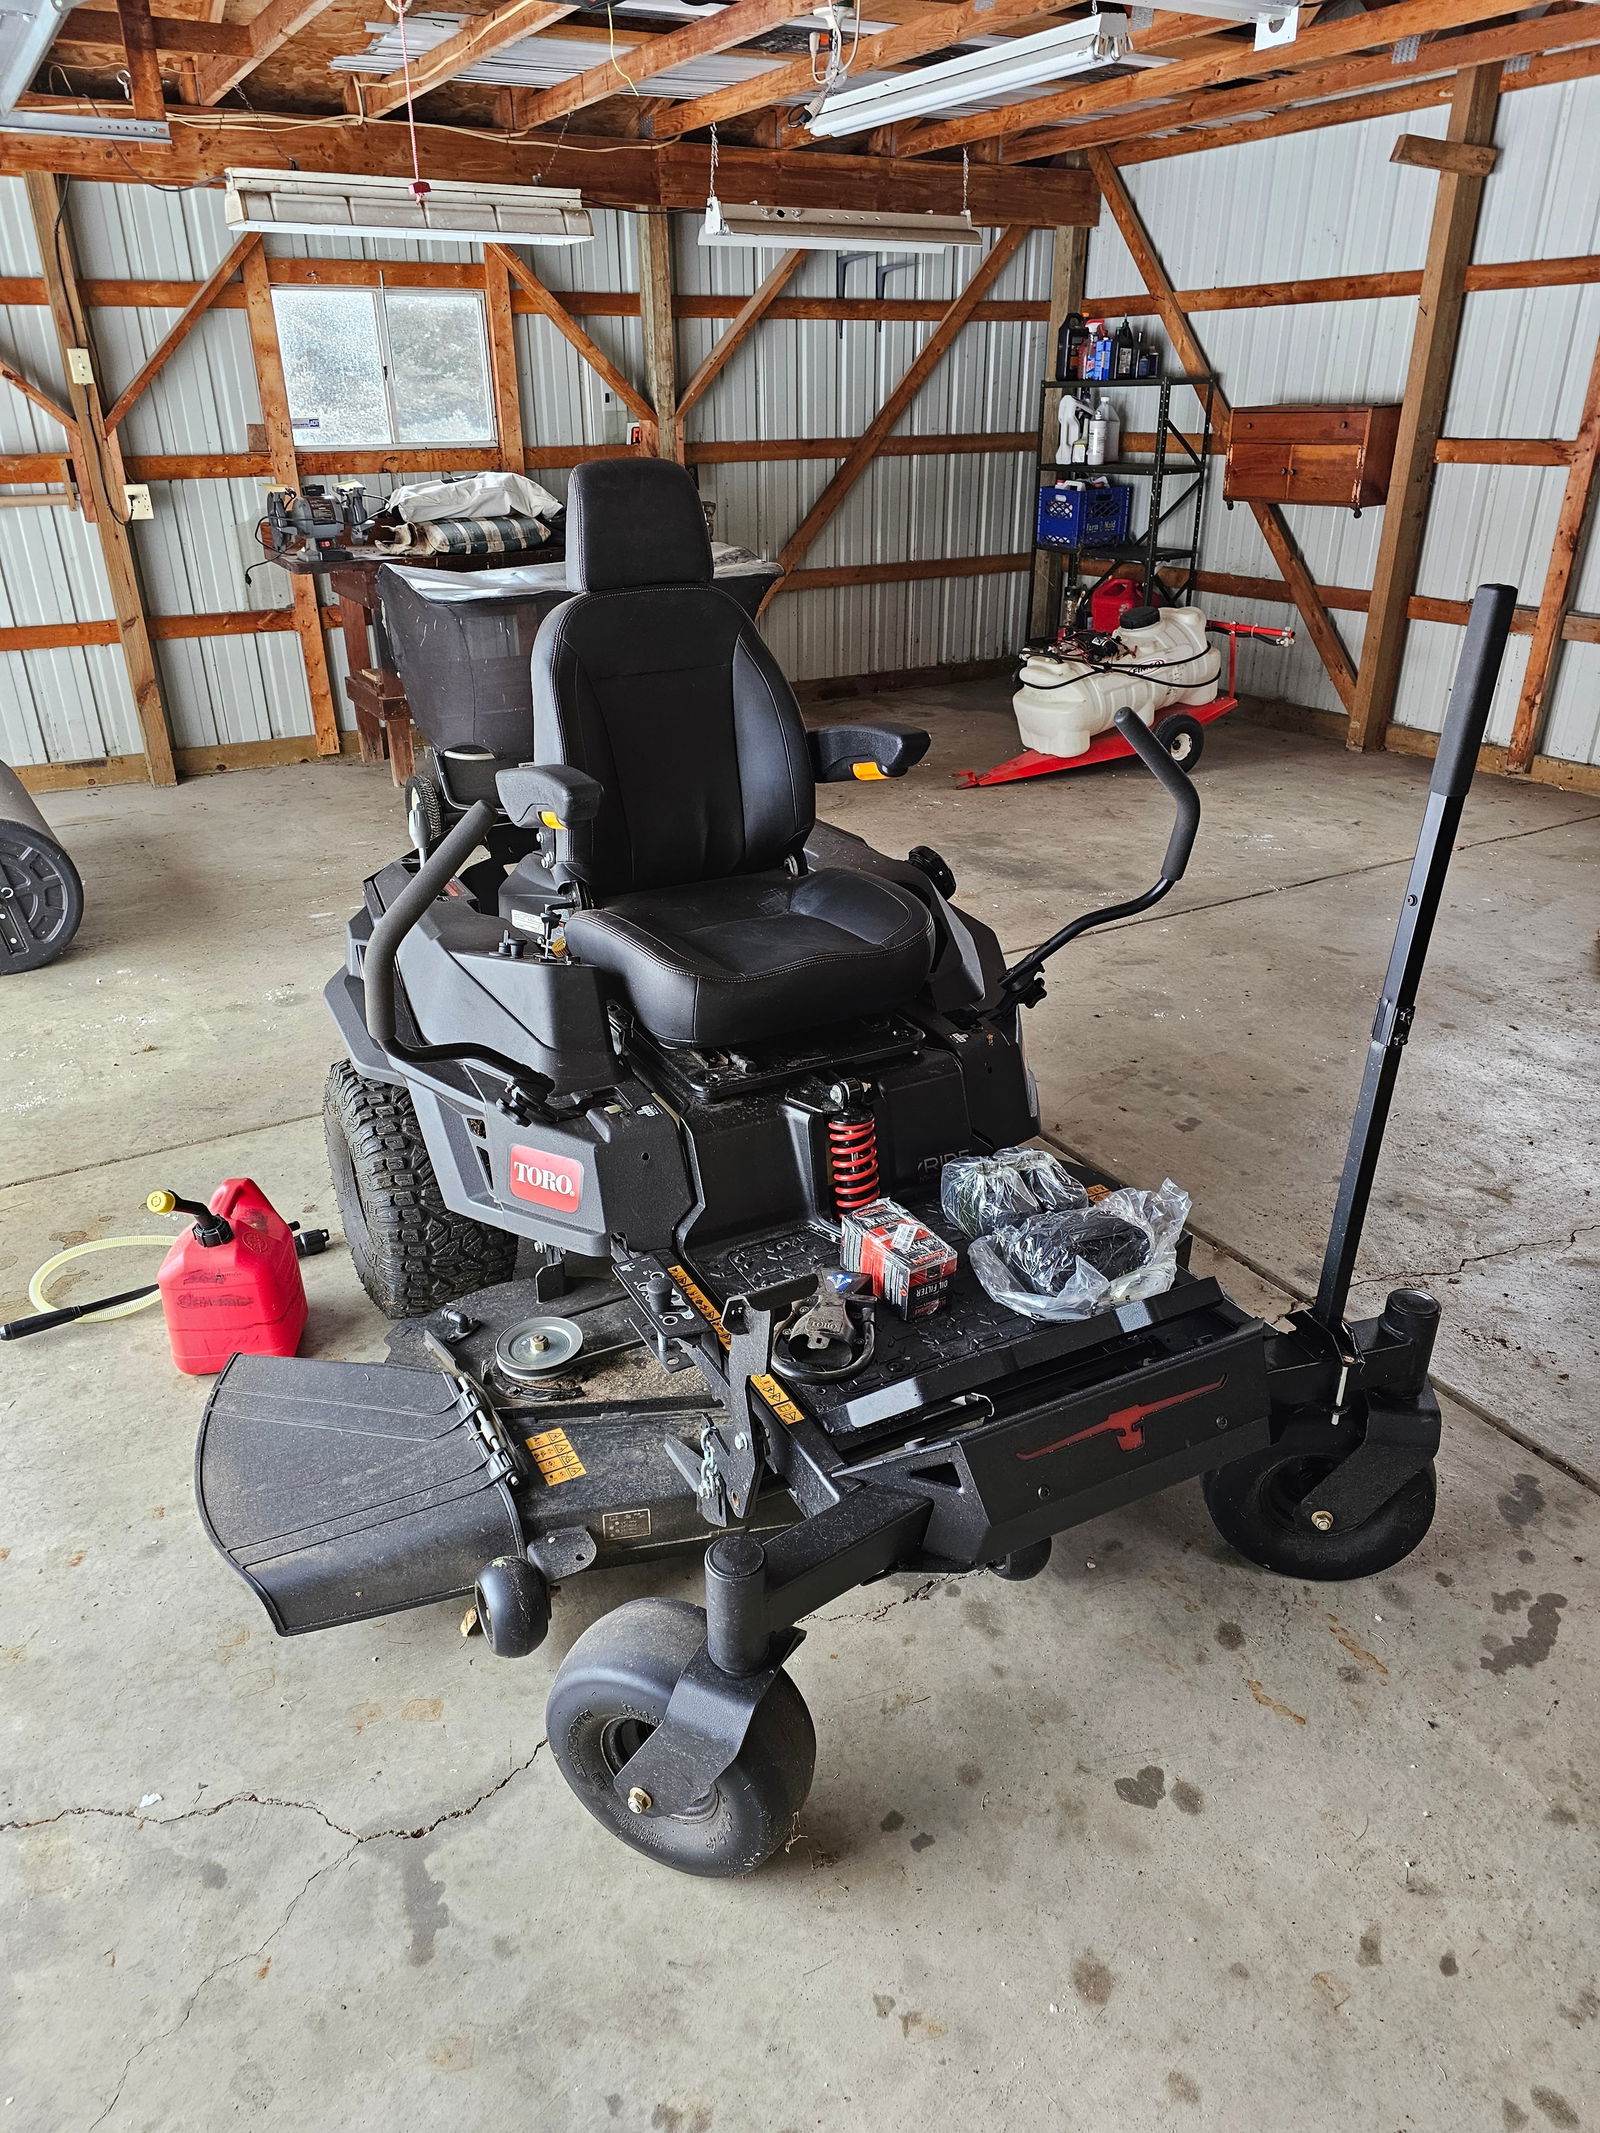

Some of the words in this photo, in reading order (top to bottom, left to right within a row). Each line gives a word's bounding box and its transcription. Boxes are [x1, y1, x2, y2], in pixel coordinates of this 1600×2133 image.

[513, 1161, 574, 1195] TORO
[916, 1282, 938, 1298] FILTER
[939, 1279, 949, 1289] OIL
